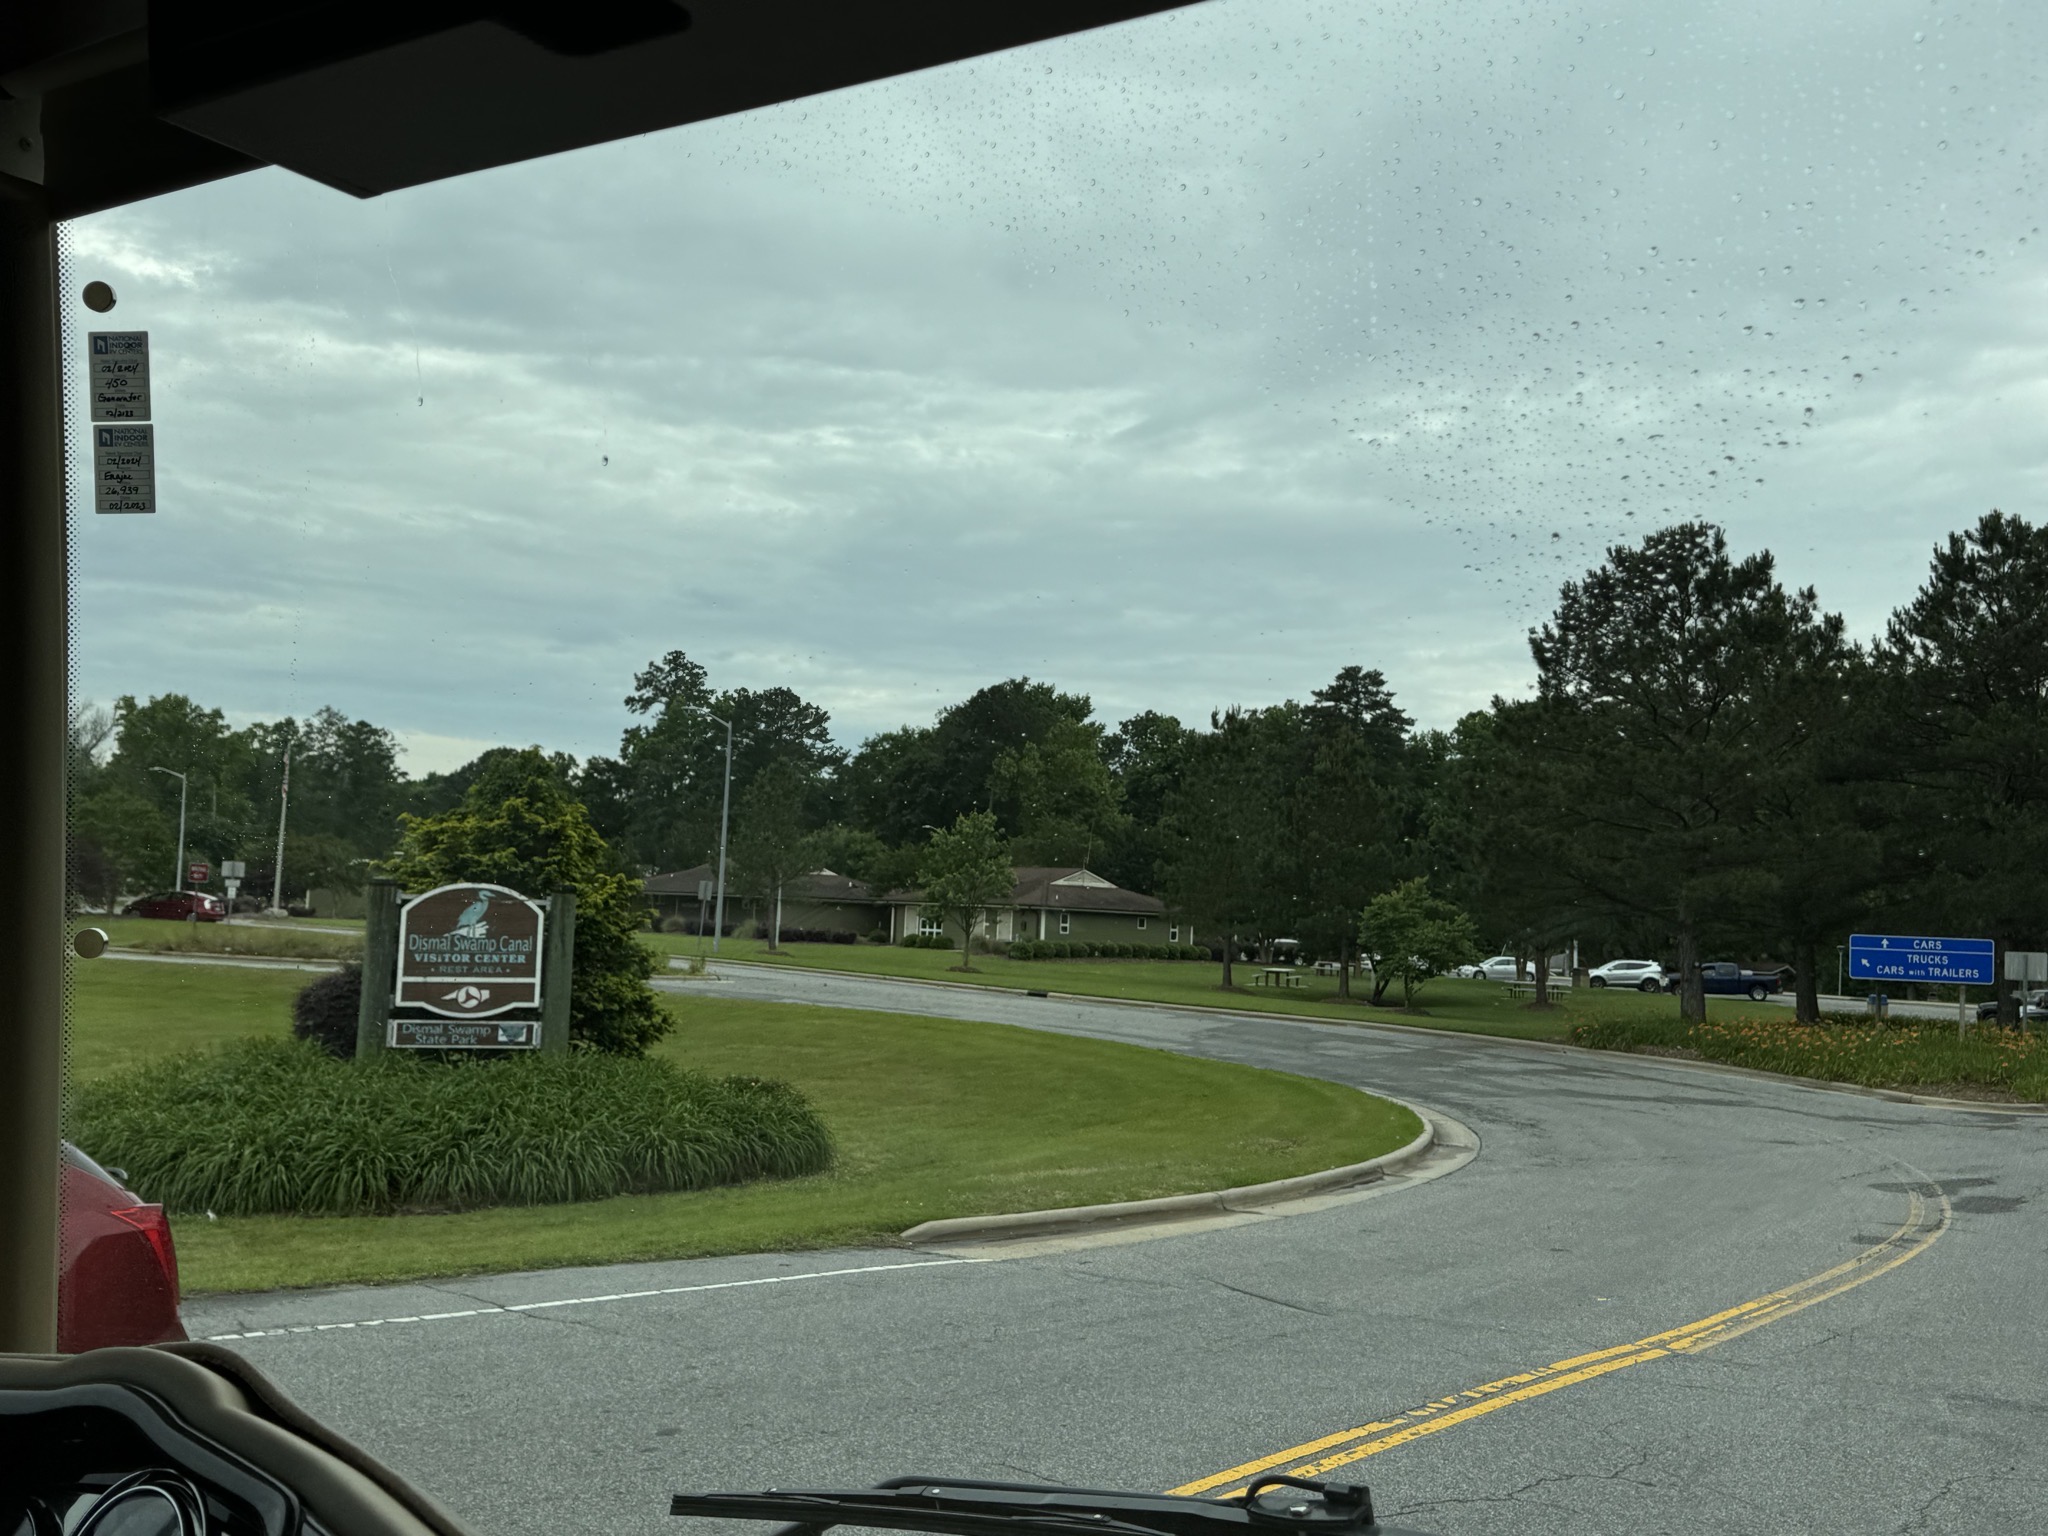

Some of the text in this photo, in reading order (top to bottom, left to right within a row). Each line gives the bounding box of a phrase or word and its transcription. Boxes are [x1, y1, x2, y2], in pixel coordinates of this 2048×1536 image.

[409, 934, 533, 953] Dismal Swamp Canal
[1913, 940, 1942, 950] CARS
[414, 953, 526, 963] VISITOR CENTER
[1907, 954, 1949, 965] TRUCKS
[439, 965, 469, 973] REST
[1876, 965, 1979, 979] CARS with TRAILERS
[402, 1024, 491, 1036] Dismal Swamp
[415, 1035, 478, 1045] State Park
